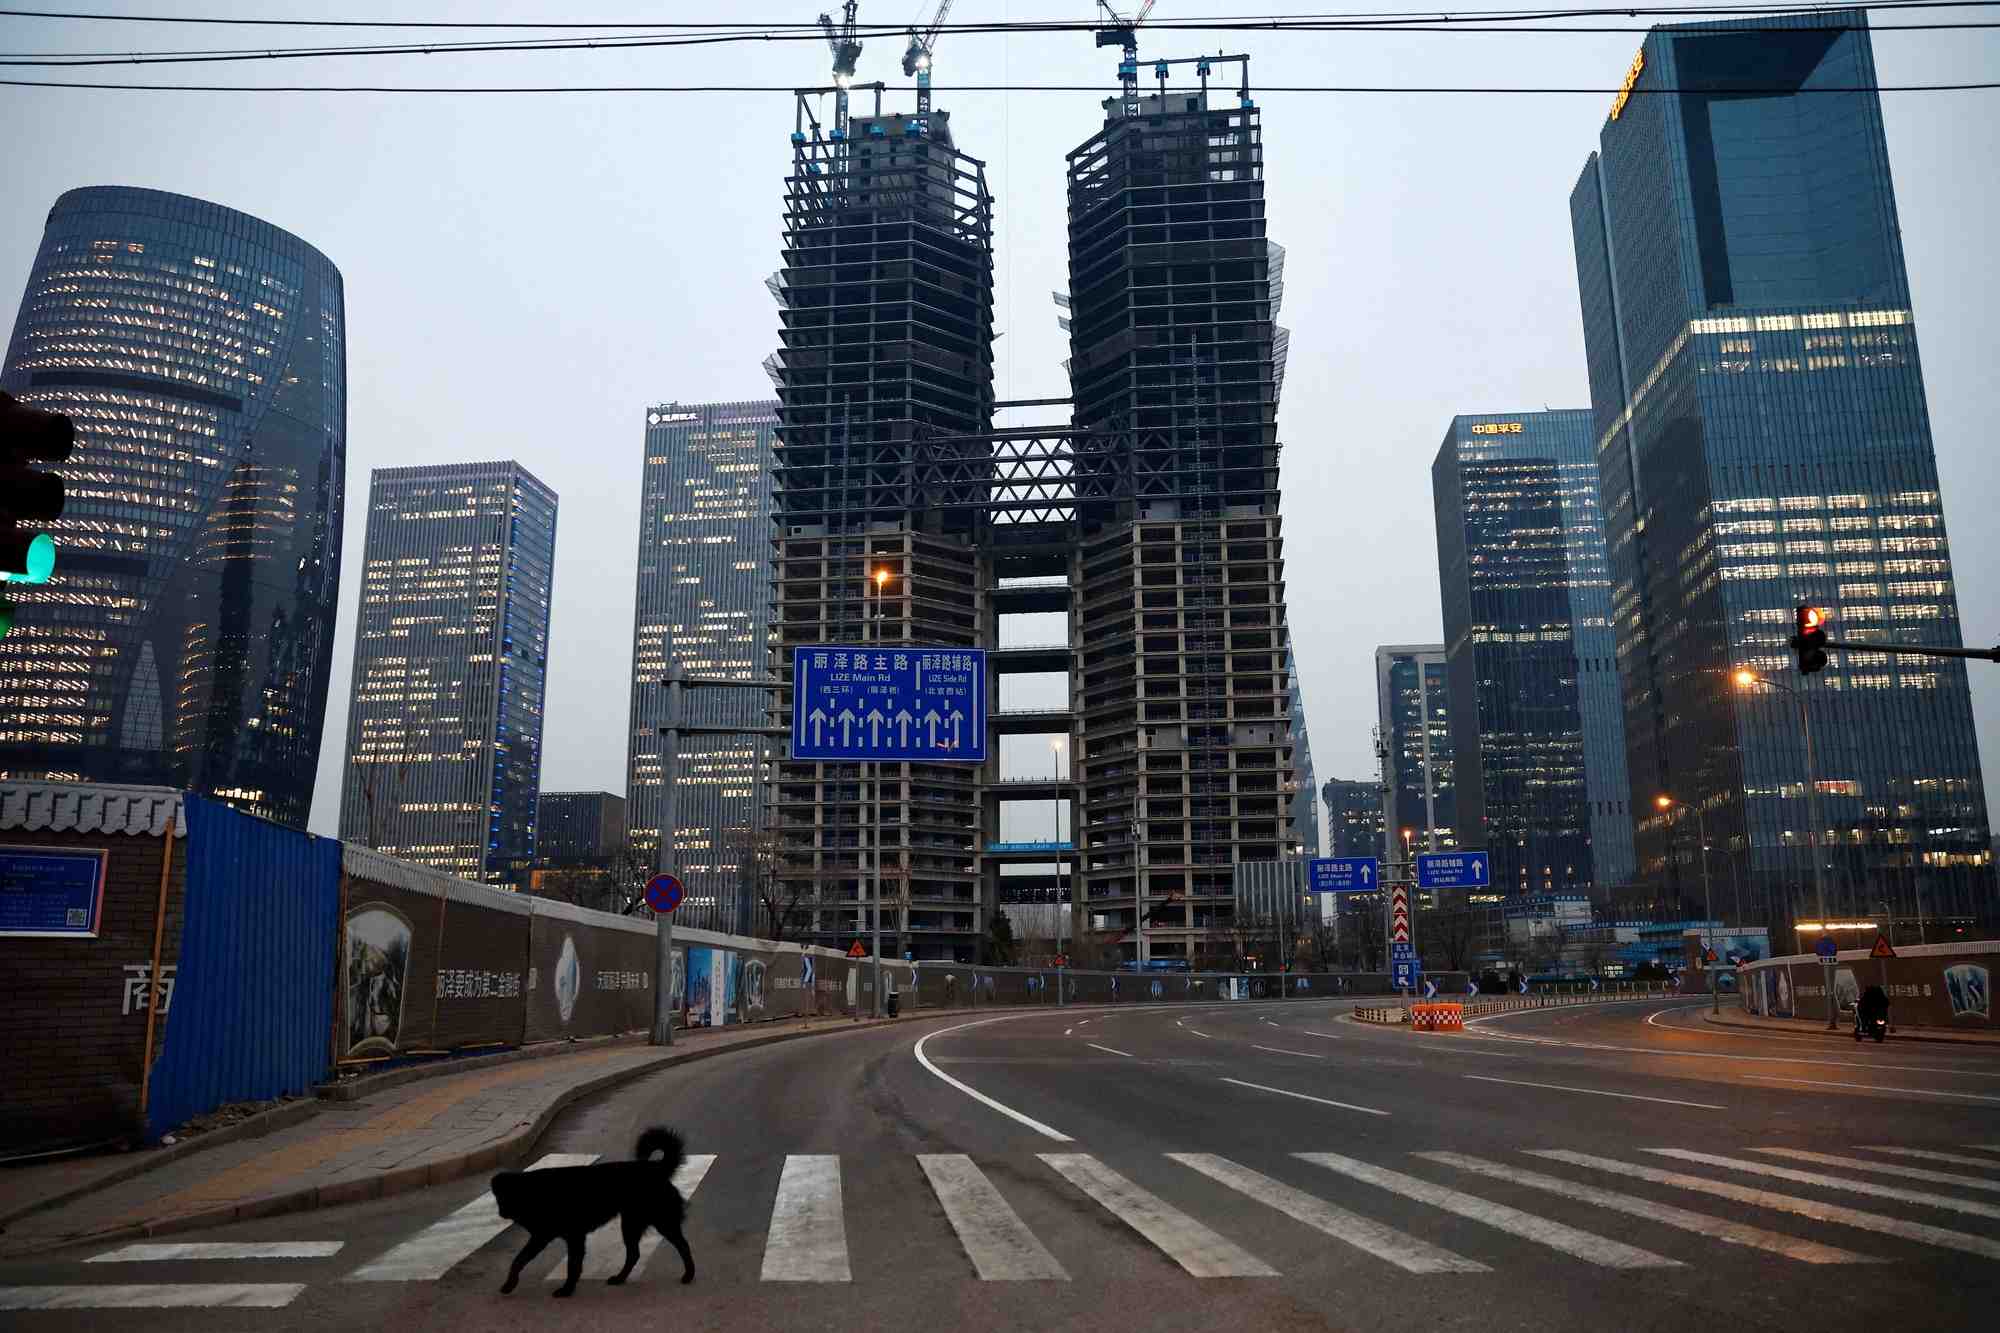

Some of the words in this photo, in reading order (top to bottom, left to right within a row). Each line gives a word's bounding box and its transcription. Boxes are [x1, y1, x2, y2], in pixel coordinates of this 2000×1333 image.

[1472, 423, 1522, 434] 中国平安
[813, 653, 909, 671] 丽泽路主路
[922, 654, 972, 671] 丽泽路辅路
[830, 673, 850, 681] LIZE
[852, 673, 876, 681] Main
[878, 673, 891, 682] Rd
[928, 674, 942, 683] LIZE
[943, 674, 957, 683] Side
[958, 674, 967, 683] Rd
